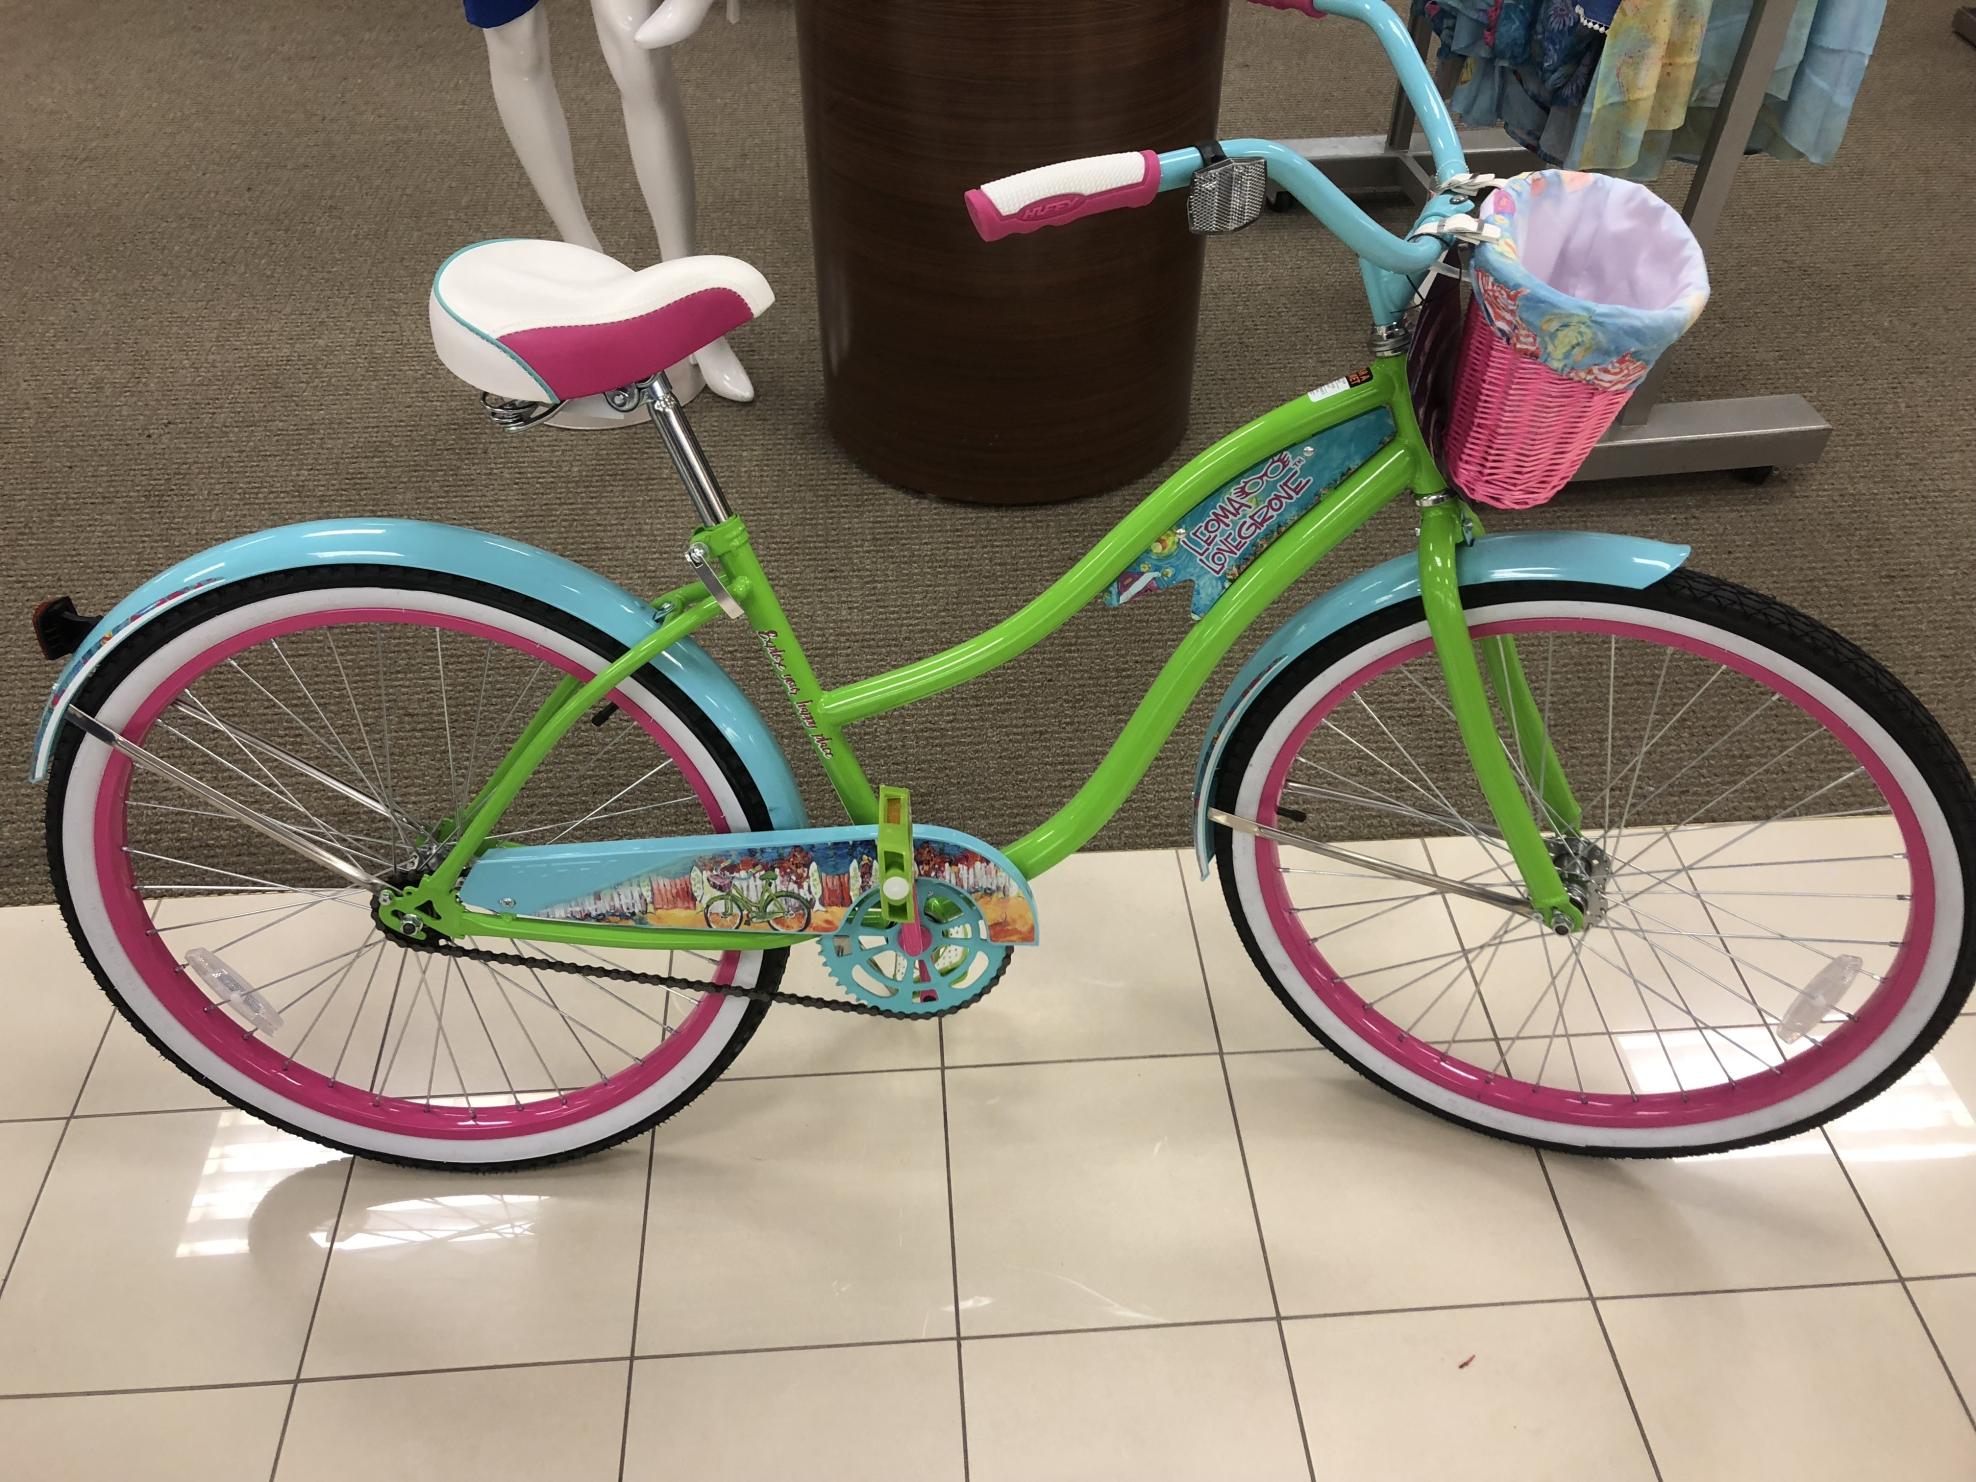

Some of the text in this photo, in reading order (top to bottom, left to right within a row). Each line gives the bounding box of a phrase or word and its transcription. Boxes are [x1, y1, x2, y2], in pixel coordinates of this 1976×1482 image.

[1022, 197, 1079, 219] HUFFY
[1180, 496, 1253, 556] LEOMA
[1198, 469, 1313, 576] LOVEGROVE
